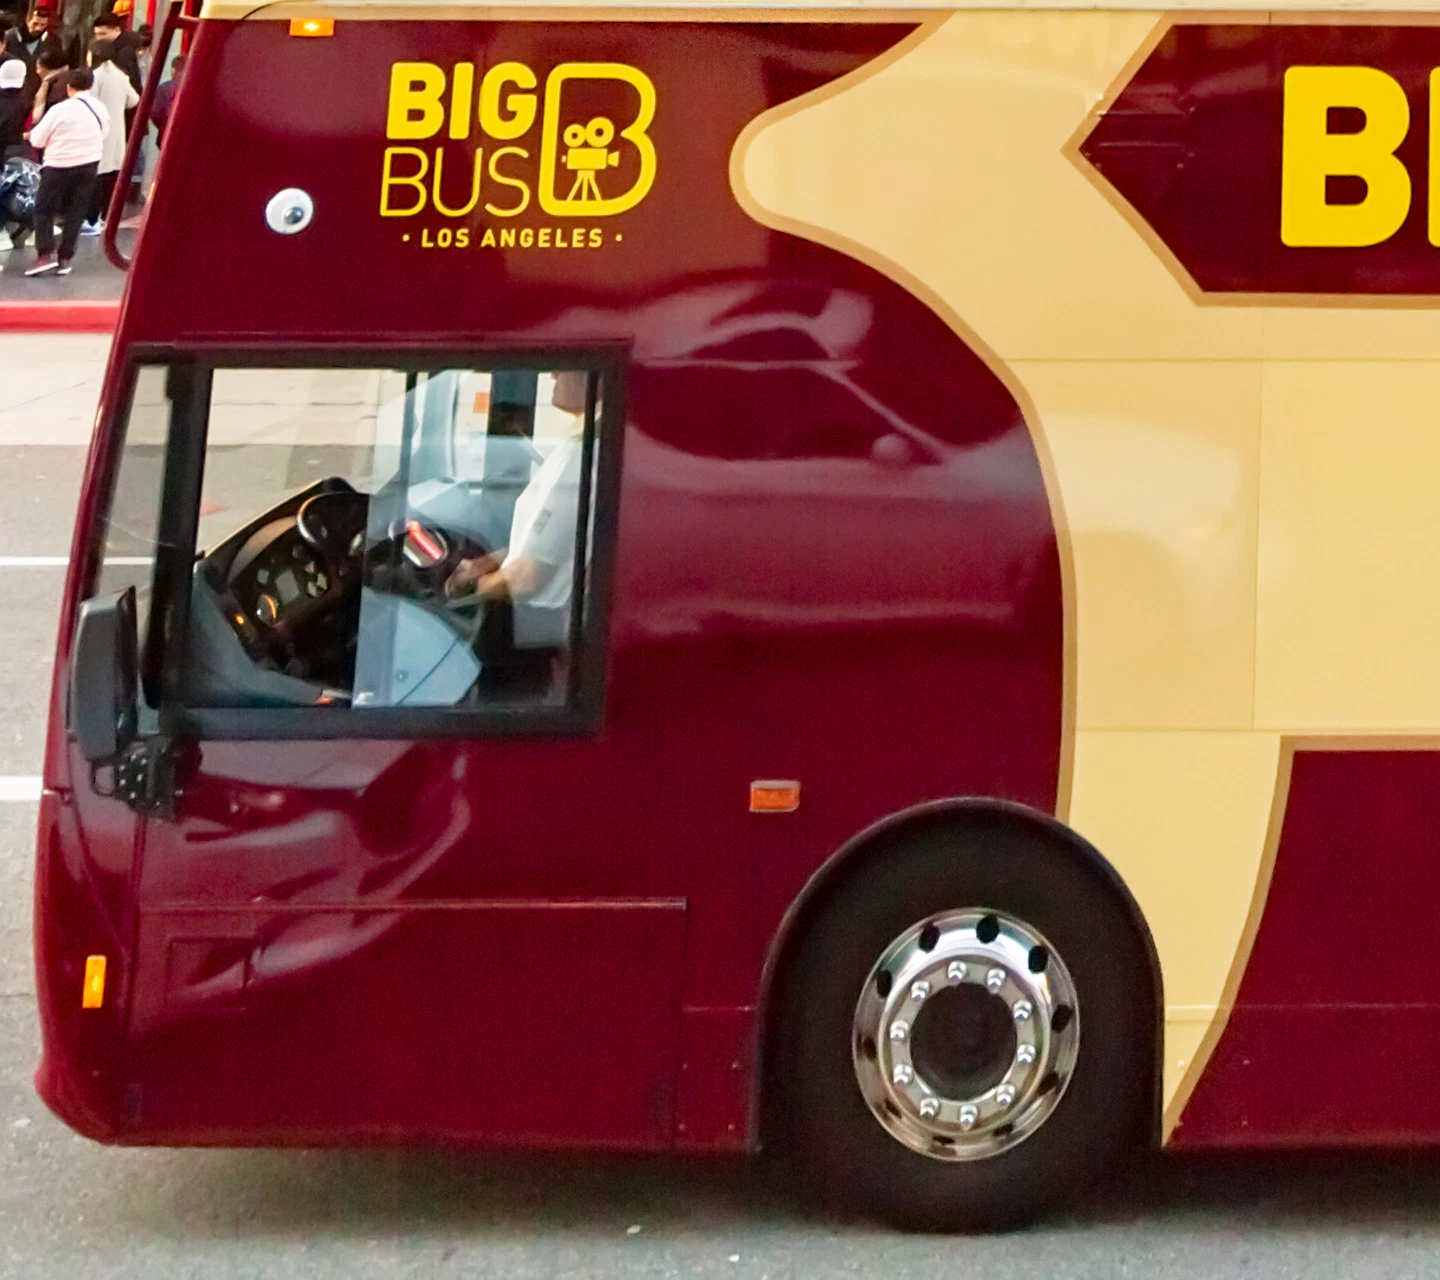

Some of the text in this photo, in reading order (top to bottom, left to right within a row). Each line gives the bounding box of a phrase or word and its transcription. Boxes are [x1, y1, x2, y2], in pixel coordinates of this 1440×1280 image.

[386, 61, 538, 140] BIG
[379, 146, 531, 217] BUS
[421, 228, 603, 248] LOS ANGELES
